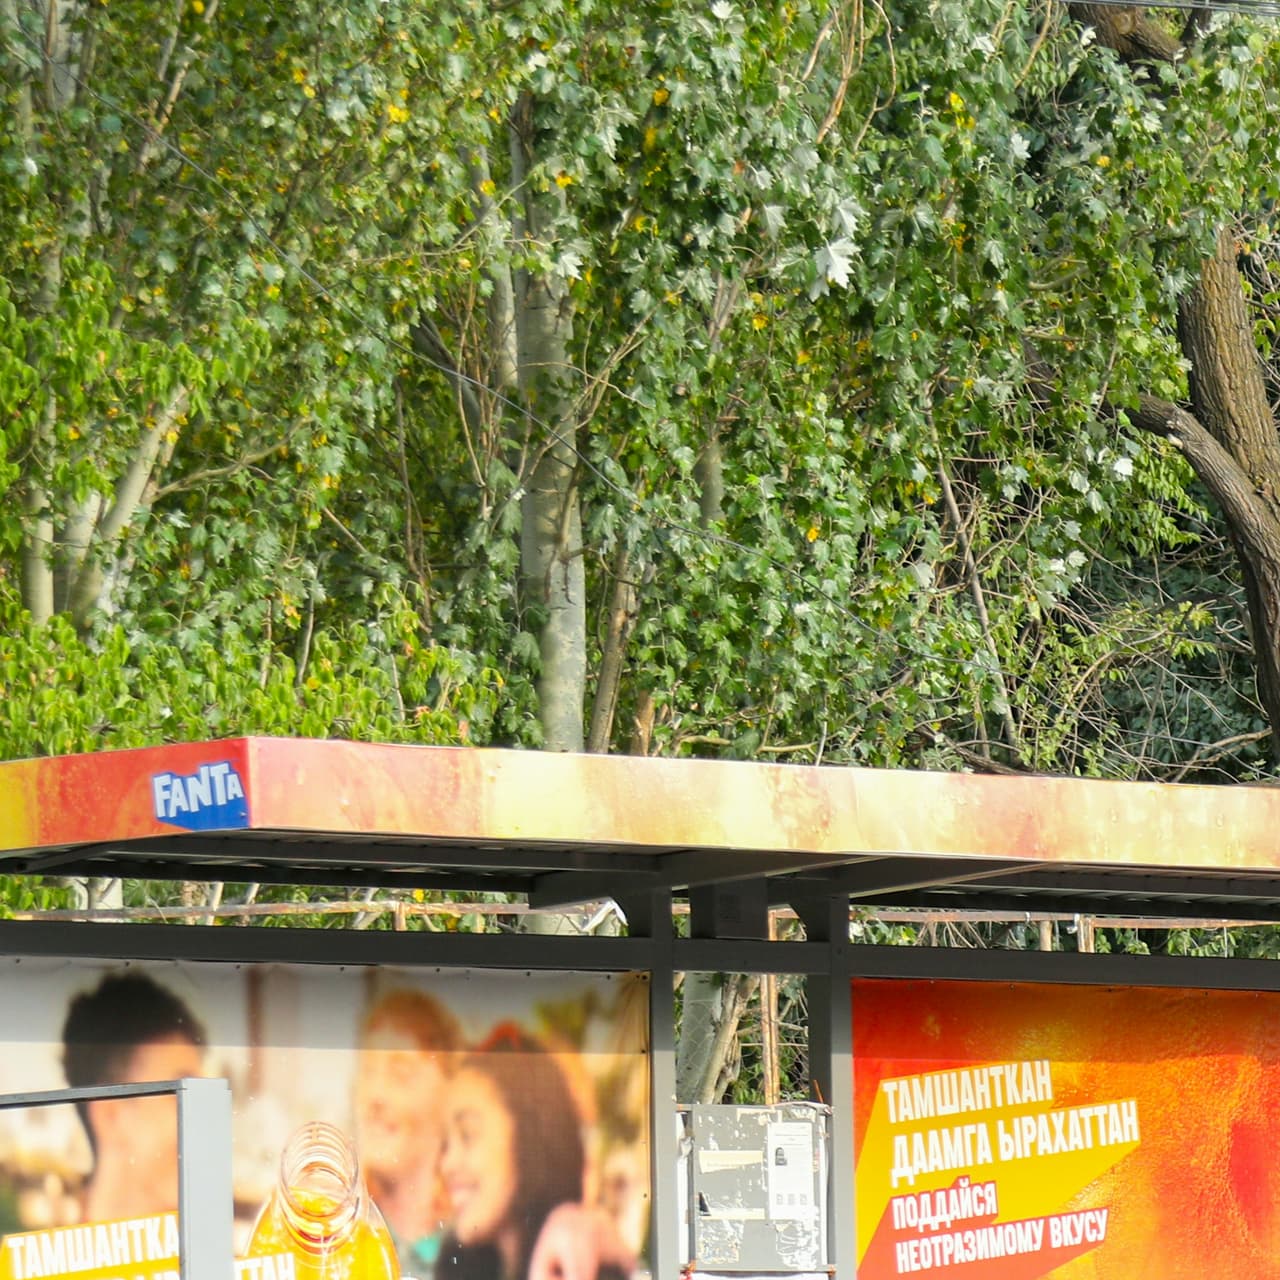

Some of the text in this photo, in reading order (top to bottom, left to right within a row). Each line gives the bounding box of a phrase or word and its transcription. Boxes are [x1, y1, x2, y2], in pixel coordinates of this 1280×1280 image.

[153, 762, 243, 818] FANTA
[883, 1060, 1053, 1124] ТАМШАНТКАН
[890, 1100, 1140, 1189] ДААМГА ЫРАХАТТАН
[891, 1177, 998, 1233] ПОДДАЙСЯ
[7, 1214, 180, 1280] ТАМШАНТКА
[895, 1208, 1109, 1274] НЕОТРАЗИМОМУ ВКУСУ
